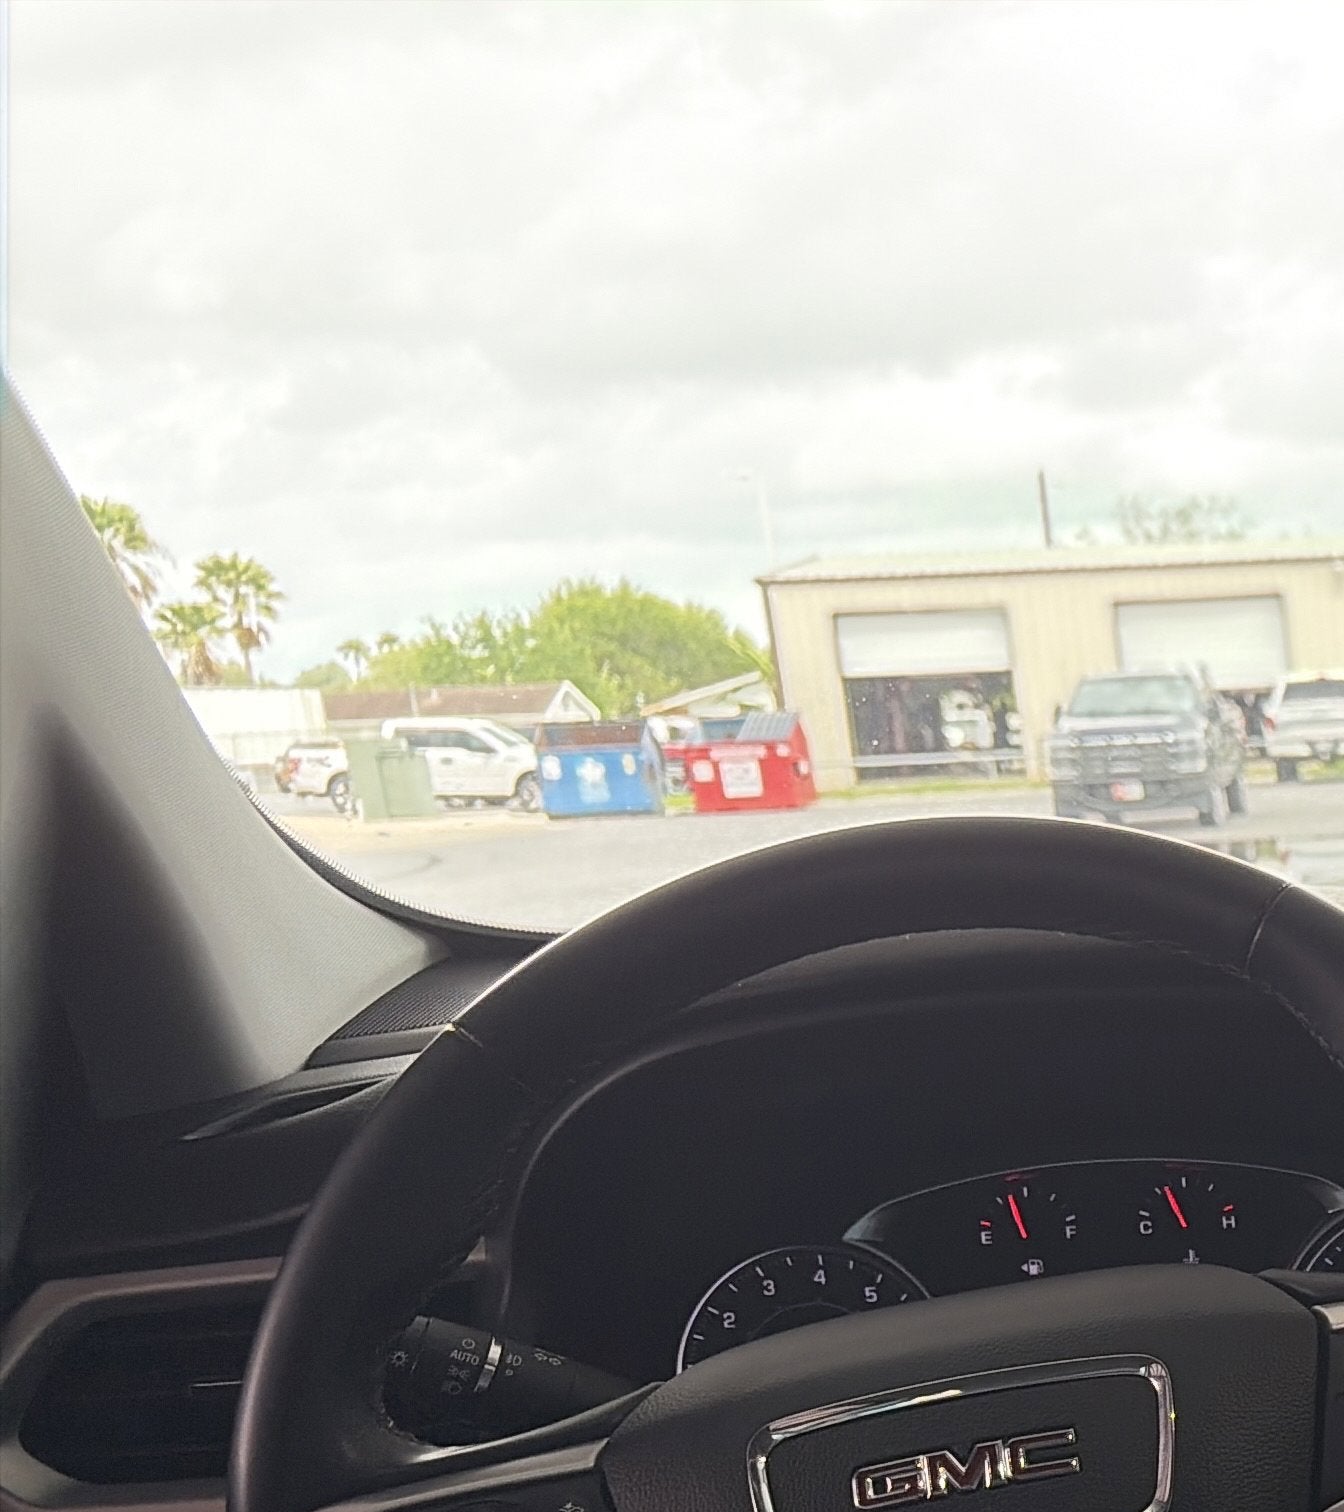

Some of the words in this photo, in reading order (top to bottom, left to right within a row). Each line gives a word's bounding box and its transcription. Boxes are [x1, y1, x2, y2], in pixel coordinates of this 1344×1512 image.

[1139, 1221, 1153, 1235] C
[1222, 1216, 1236, 1230] H
[980, 1231, 993, 1245] E
[1065, 1225, 1077, 1239] F
[813, 1269, 827, 1285] 4
[762, 1279, 776, 1296] 3
[864, 1286, 878, 1303] 5
[722, 1312, 736, 1329] 2
[450, 1349, 480, 1366] AUTO
[851, 1427, 1081, 1510] GMC
